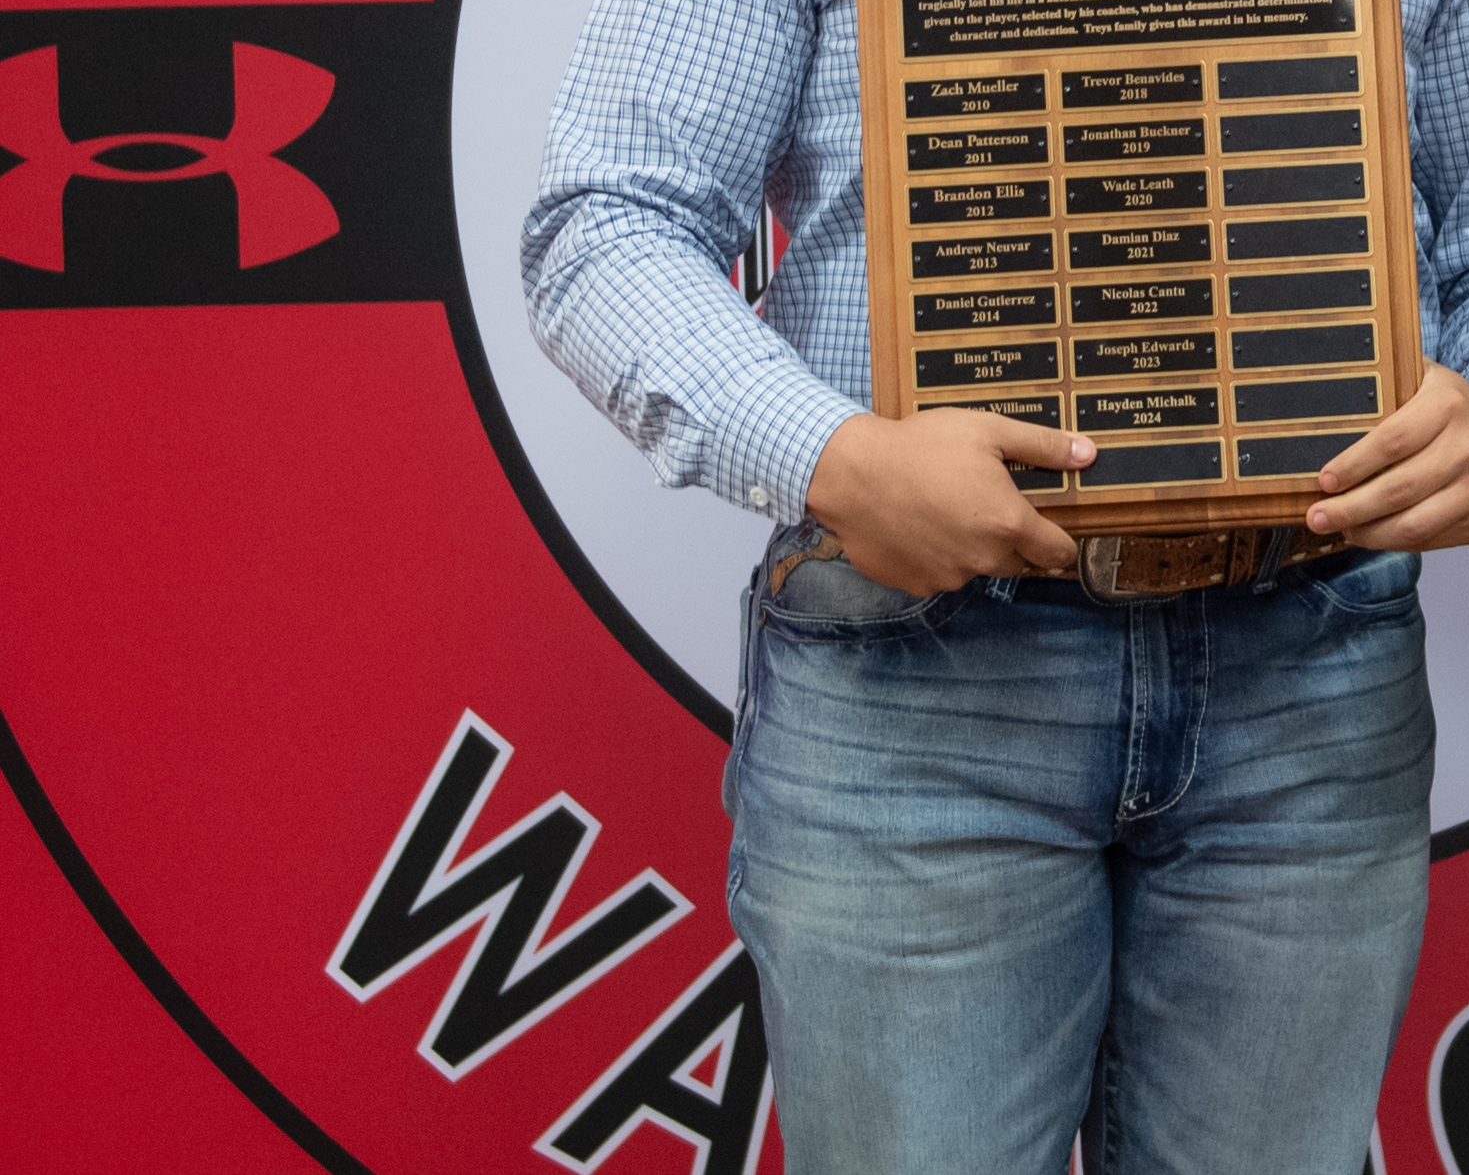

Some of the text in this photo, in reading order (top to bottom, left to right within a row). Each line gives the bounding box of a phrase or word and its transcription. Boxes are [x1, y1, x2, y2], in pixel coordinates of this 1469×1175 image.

[924, 17, 951, 29] given
[953, 16, 965, 25] to
[966, 14, 983, 25] the
[985, 12, 1020, 27] player,
[1021, 9, 1062, 21] selected
[1064, 8, 1078, 21] by
[1079, 6, 1095, 18] his
[1096, 4, 1139, 17] coaches,
[1141, 2, 1164, 14] who
[1165, 1, 1183, 12] has
[949, 12, 1309, 42] character and dedication. Treys family gives this award in his memory.
[1081, 71, 1186, 88] Trevor Benavides
[931, 80, 1020, 98] Zach Mueller
[1119, 88, 1148, 101] 2018
[961, 99, 991, 112] 2010
[1080, 125, 1191, 142] Jonathan Buckner
[927, 133, 1029, 150] Dean Patterson
[1122, 141, 1151, 154] 2019
[964, 151, 993, 165] 2011
[1102, 177, 1175, 193] Wade Leath
[934, 185, 1025, 203] Brandon Ellis
[1124, 194, 1153, 207] 2020
[965, 205, 995, 218] 2012
[1101, 230, 1180, 246] Damian Diaz
[935, 240, 1031, 257] Andrew Neuvar
[1126, 246, 1155, 259] 2021
[969, 256, 998, 270] 2013
[1101, 286, 1186, 300] Nicolas Cantu
[935, 294, 1036, 310] Daniel Gutierrez
[1130, 301, 1159, 314] 2022
[972, 310, 1000, 323] 2014
[1096, 339, 1195, 357] Joseph Edwards
[953, 350, 1022, 365] Blane Tupa
[1132, 356, 1161, 369] 2023
[974, 365, 1003, 379] 2015
[988, 402, 1043, 414] Williams
[1096, 394, 1197, 413] Hayden Michalk
[1133, 412, 1162, 425] 2024
